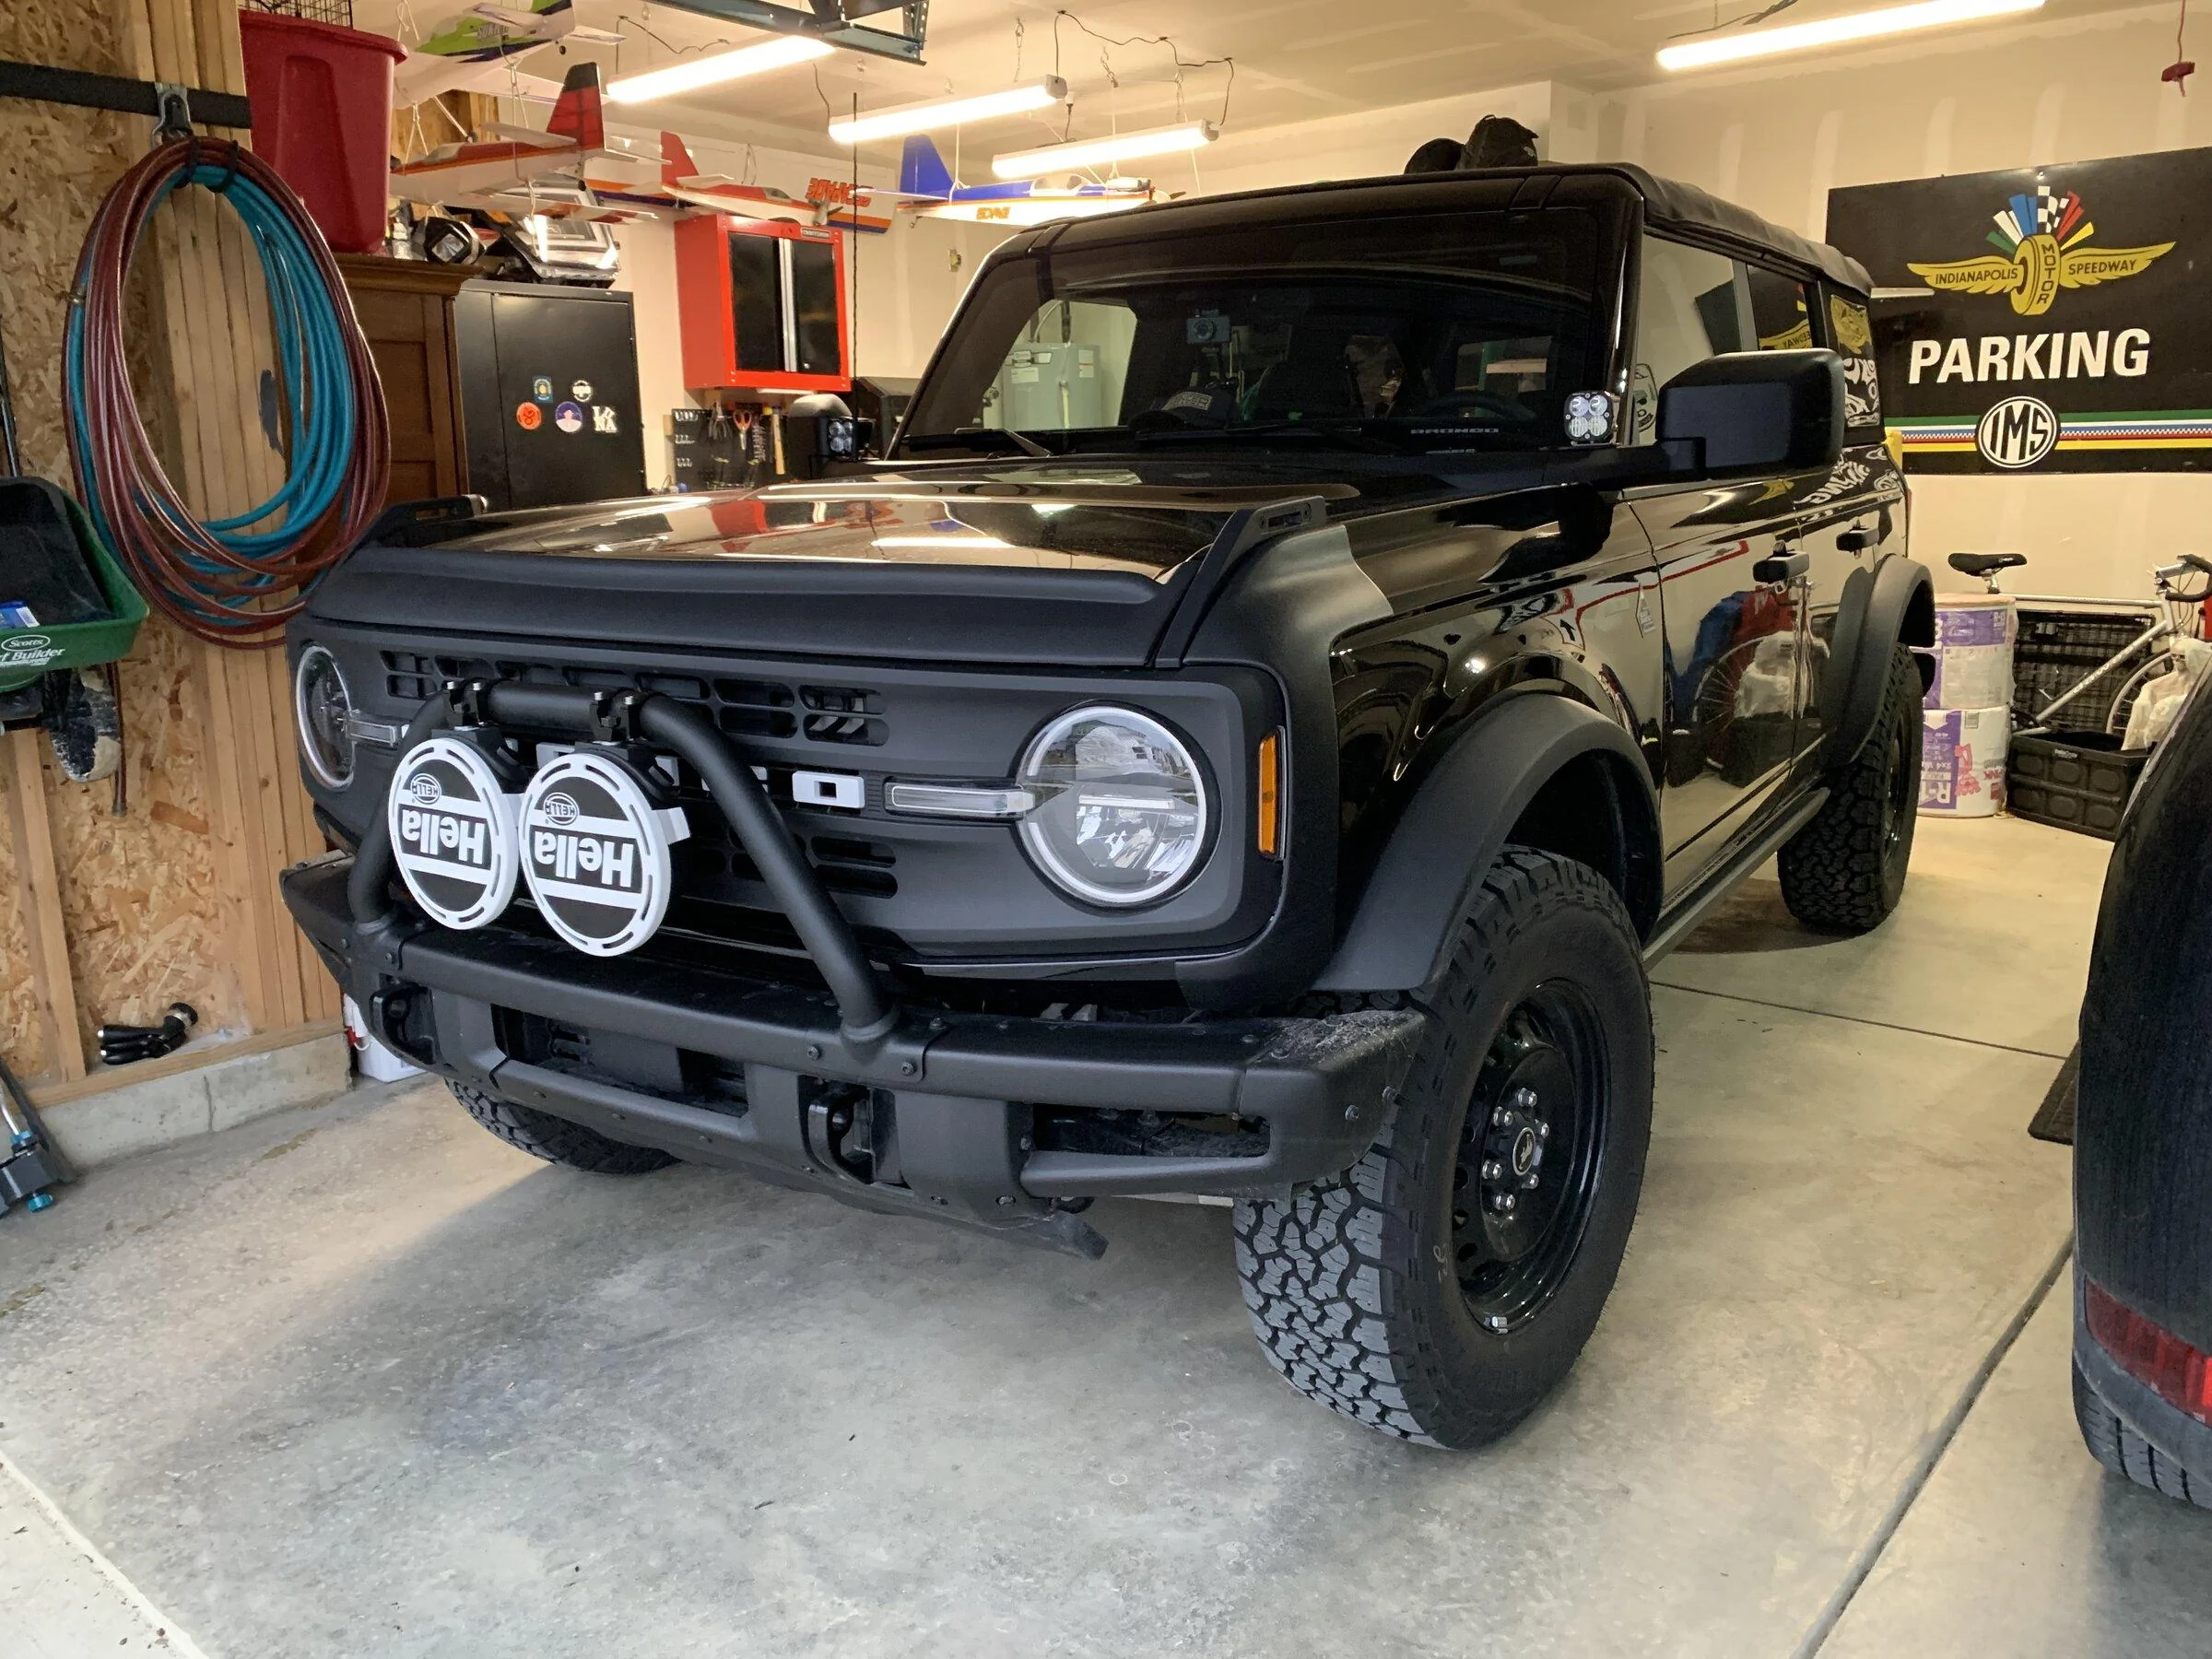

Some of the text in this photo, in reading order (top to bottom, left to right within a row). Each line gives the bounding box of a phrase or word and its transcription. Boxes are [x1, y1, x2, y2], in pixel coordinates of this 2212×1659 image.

[1935, 243, 2136, 304] INDIANAPOLIS MOTOR SPEEDWAY
[1908, 328, 2150, 384] PARKING
[1990, 404, 2048, 461] IMS
[9, 639, 44, 648] Scotts
[12, 647, 66, 662] Builder
[410, 782, 439, 797] HELLA
[545, 801, 576, 816] HELLA
[401, 808, 485, 865] Hella
[534, 830, 634, 888] Hella
